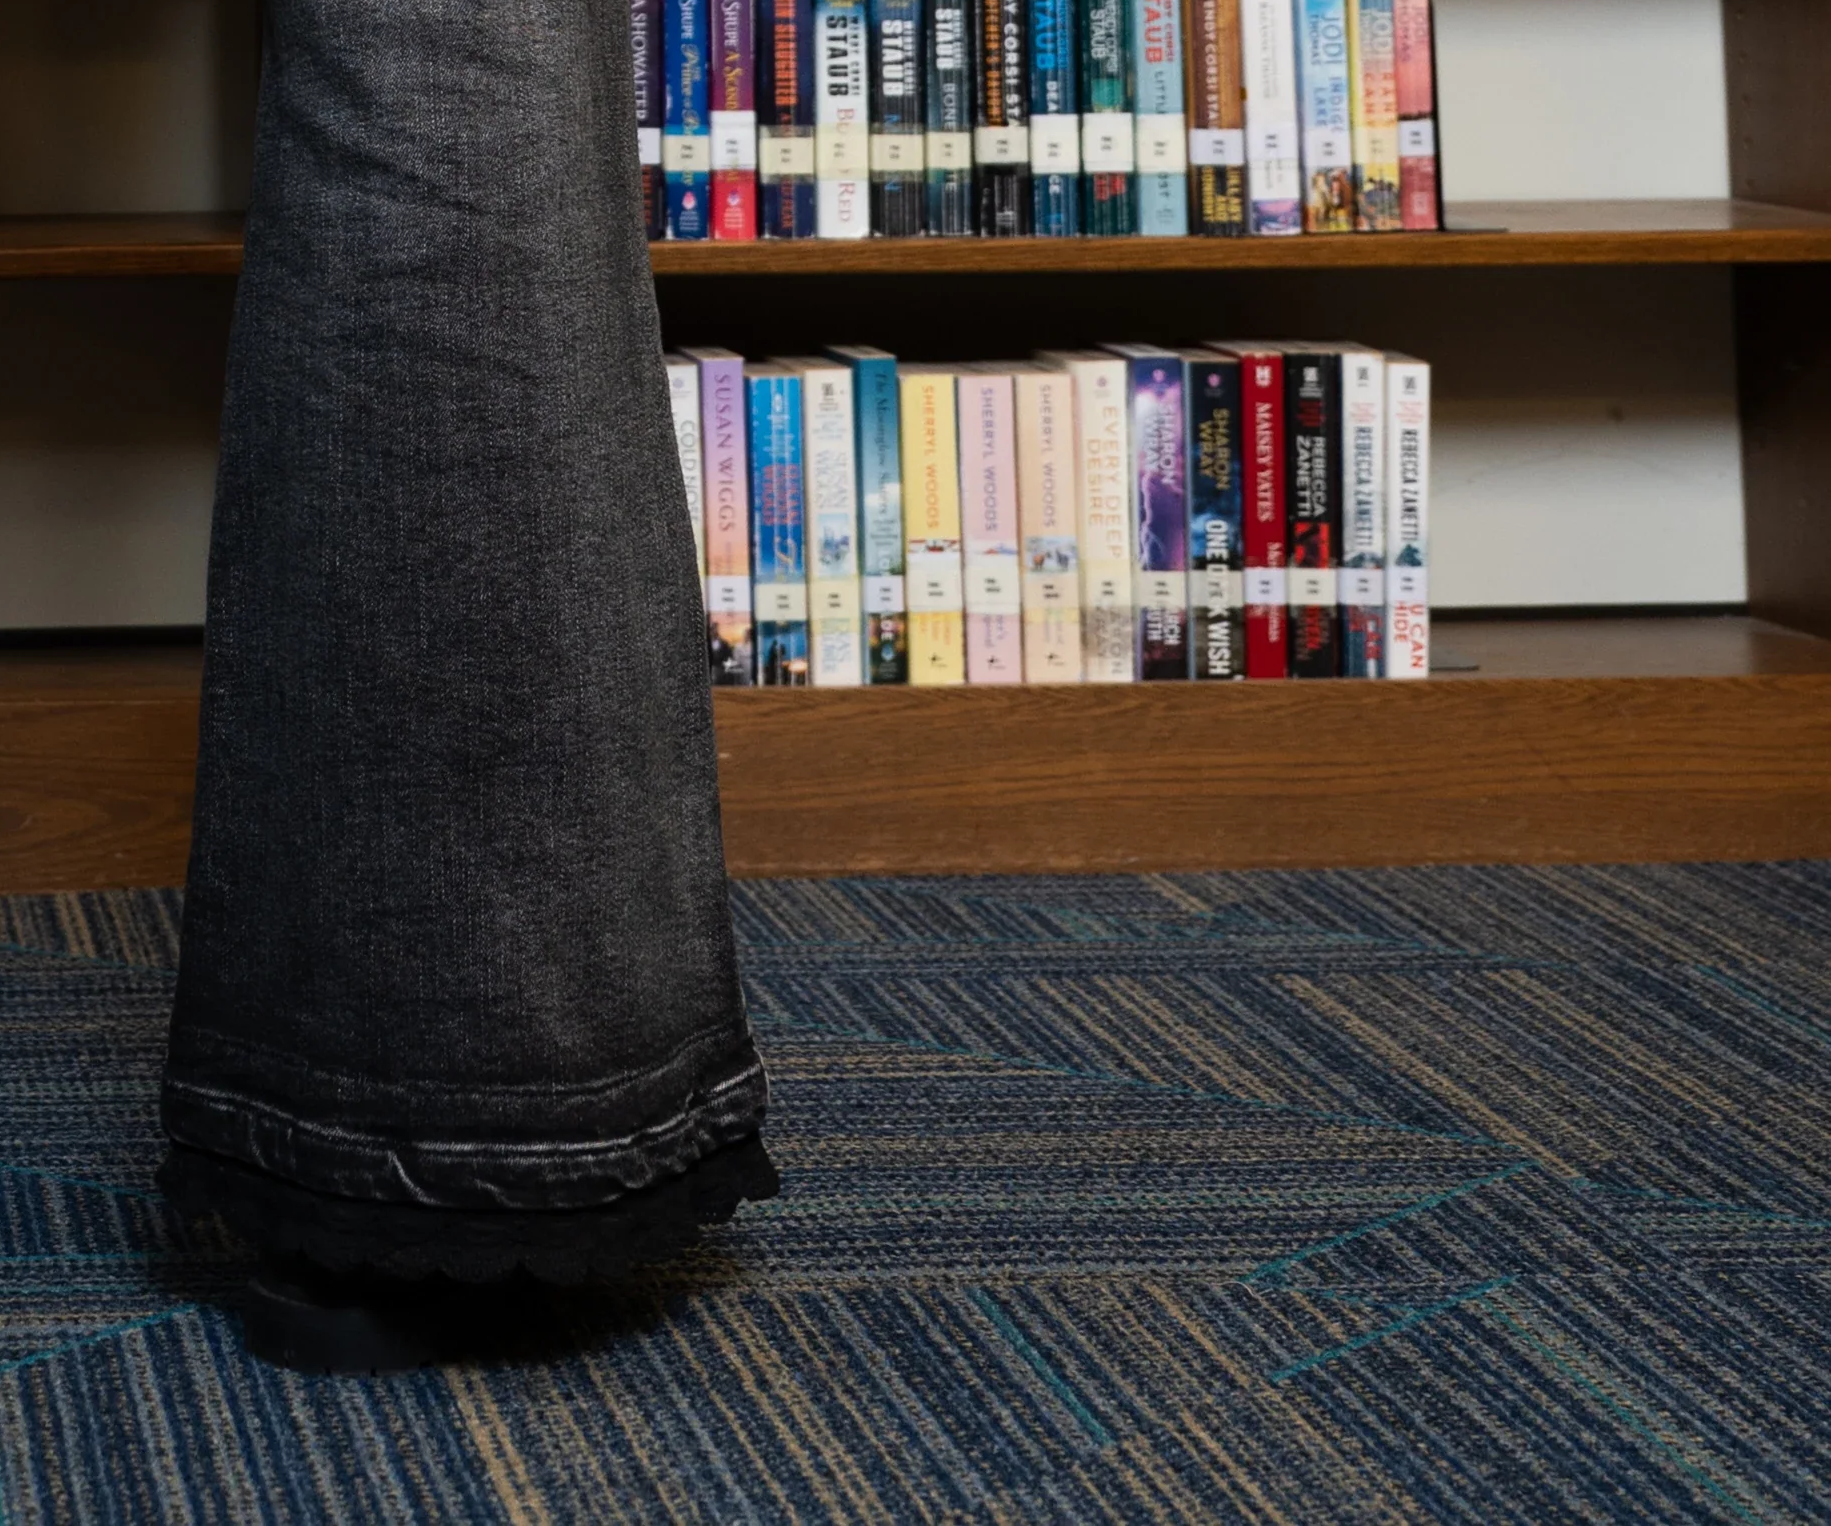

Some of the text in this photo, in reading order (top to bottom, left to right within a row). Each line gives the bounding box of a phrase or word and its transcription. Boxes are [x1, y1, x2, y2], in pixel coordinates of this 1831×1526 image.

[775, 24, 797, 106] SLAUGHTER
[827, 15, 848, 97] STAUB
[881, 20, 901, 97] STAUB
[935, 7, 953, 70] STAUB
[1003, 22, 1018, 85] CORSI
[1090, 9, 1105, 60] STAUB
[1323, 12, 1344, 65] JODI
[713, 372, 735, 533] SUSAN WIGGS
[921, 385, 940, 529] SHERRYL WOODS
[981, 387, 998, 531] SHERRYL WOODS
[1040, 384, 1055, 528] SHERRYL WOODS
[1087, 438, 1103, 527] DESIRE
[1102, 406, 1123, 558] EVERY DEEP
[1198, 420, 1214, 479] WRAY
[1213, 408, 1230, 490] SHARON
[1255, 402, 1275, 522] MAISEY YATES
[1296, 435, 1312, 518] ZANETTI
[1312, 435, 1326, 517] REBECCA
[1205, 519, 1229, 560] ONE
[1207, 622, 1231, 674] WISH
[1411, 623, 1425, 668] CAN
